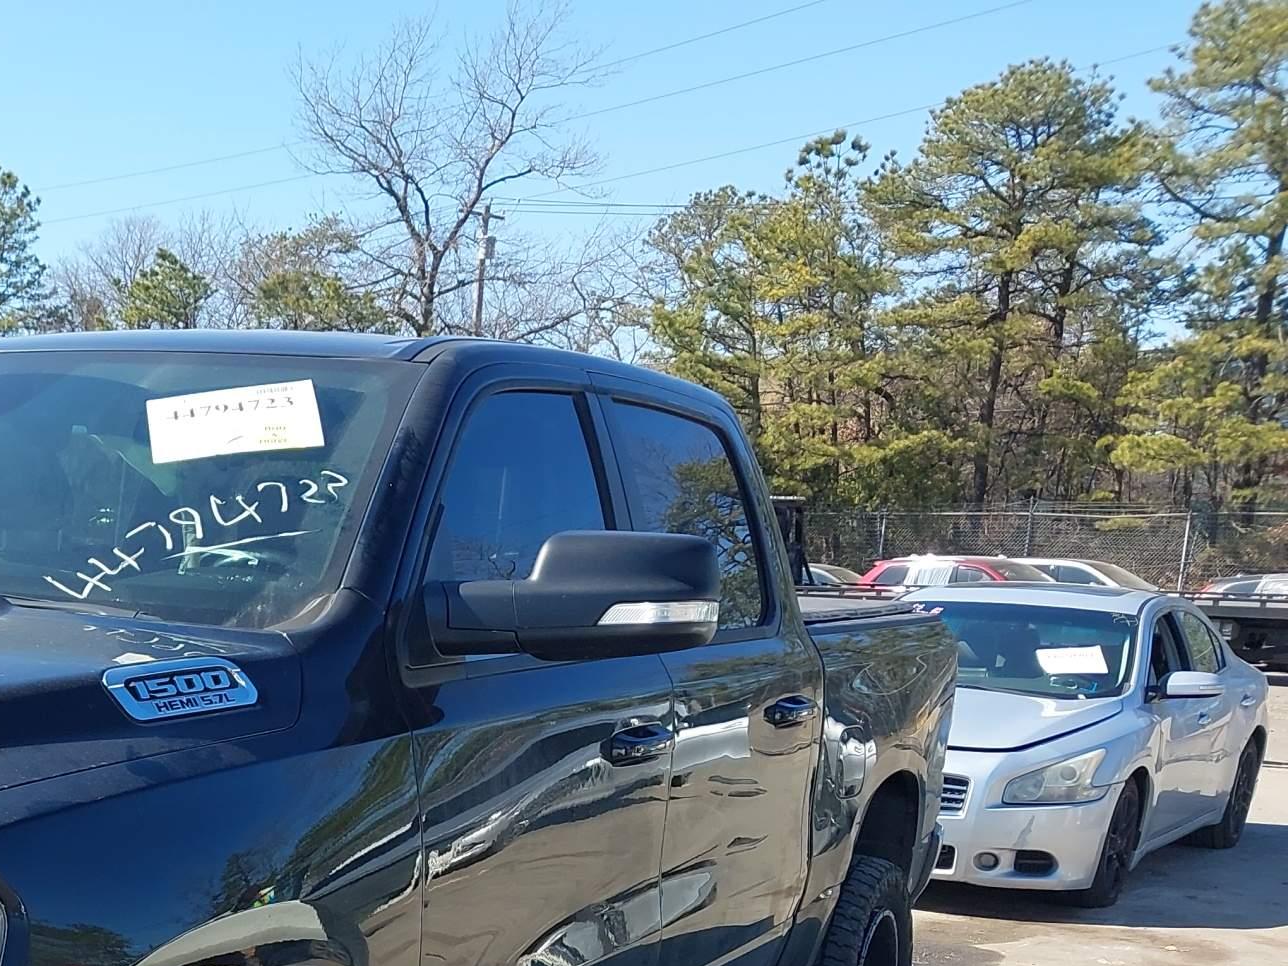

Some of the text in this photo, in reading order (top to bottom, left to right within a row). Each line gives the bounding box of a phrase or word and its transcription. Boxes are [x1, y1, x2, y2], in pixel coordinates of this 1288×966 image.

[43, 470, 348, 599] 44794723
[128, 669, 231, 700] 1500
[154, 693, 235, 713] HEMI 5.7L
